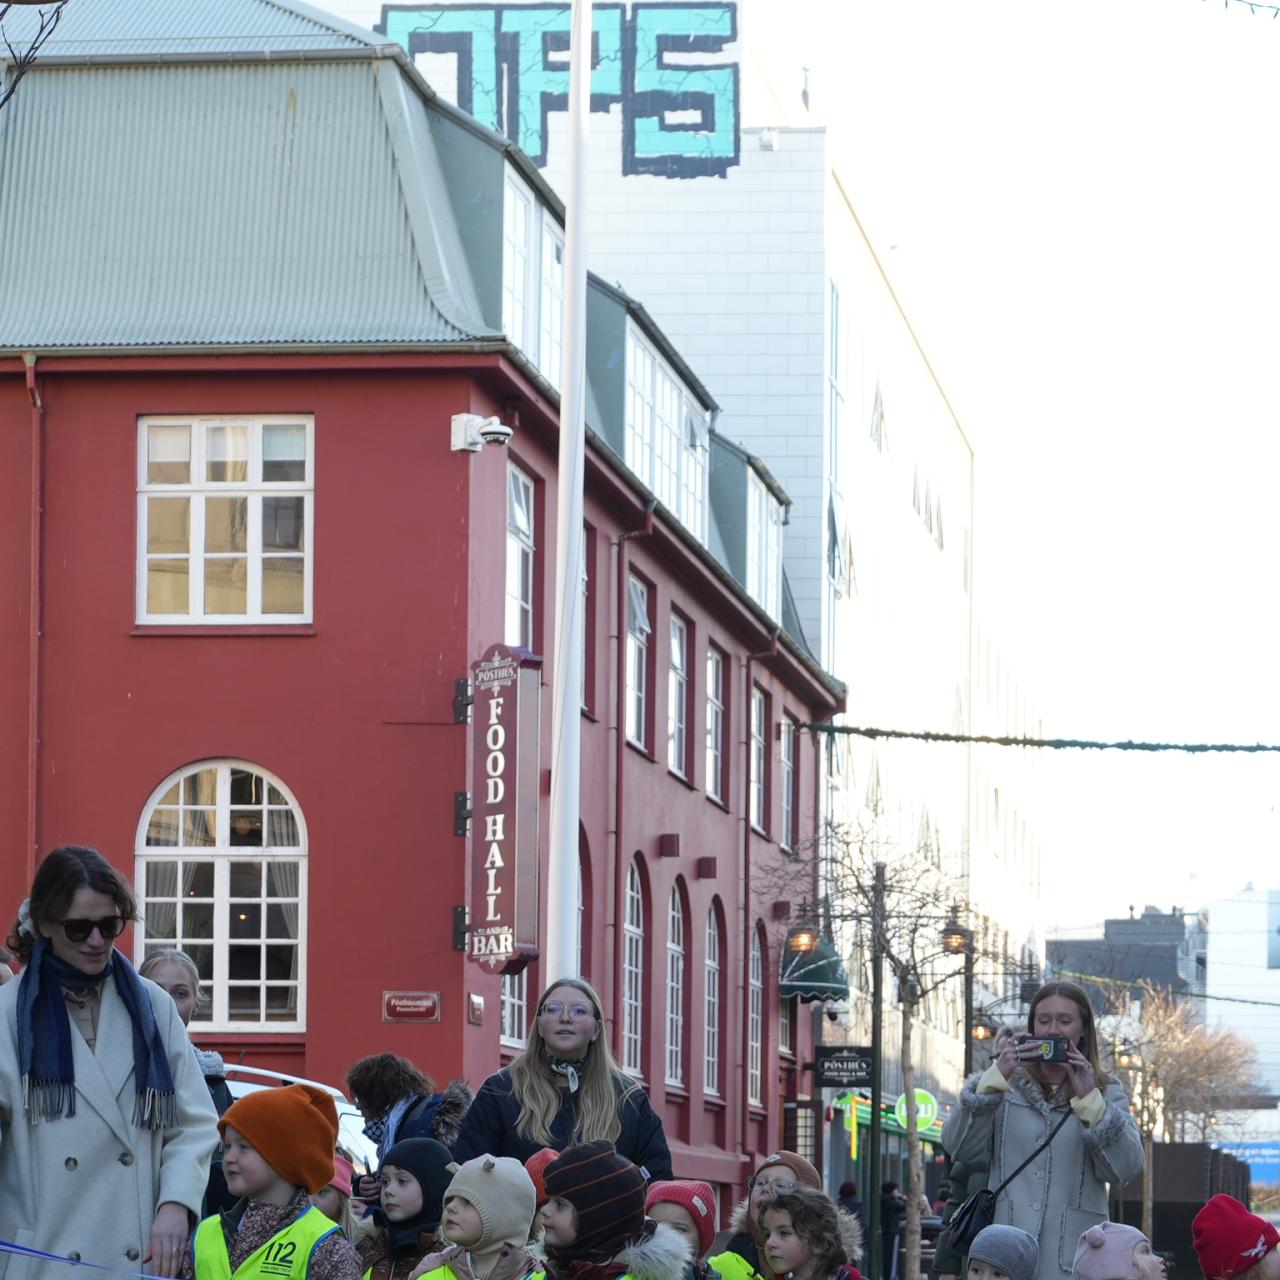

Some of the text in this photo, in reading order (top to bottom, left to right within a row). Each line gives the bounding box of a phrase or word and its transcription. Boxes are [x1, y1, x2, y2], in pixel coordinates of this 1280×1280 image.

[484, 697, 506, 921] FOOD HALL
[486, 926, 501, 935] AND
[472, 932, 514, 956] BAR
[265, 1241, 297, 1265] 112
